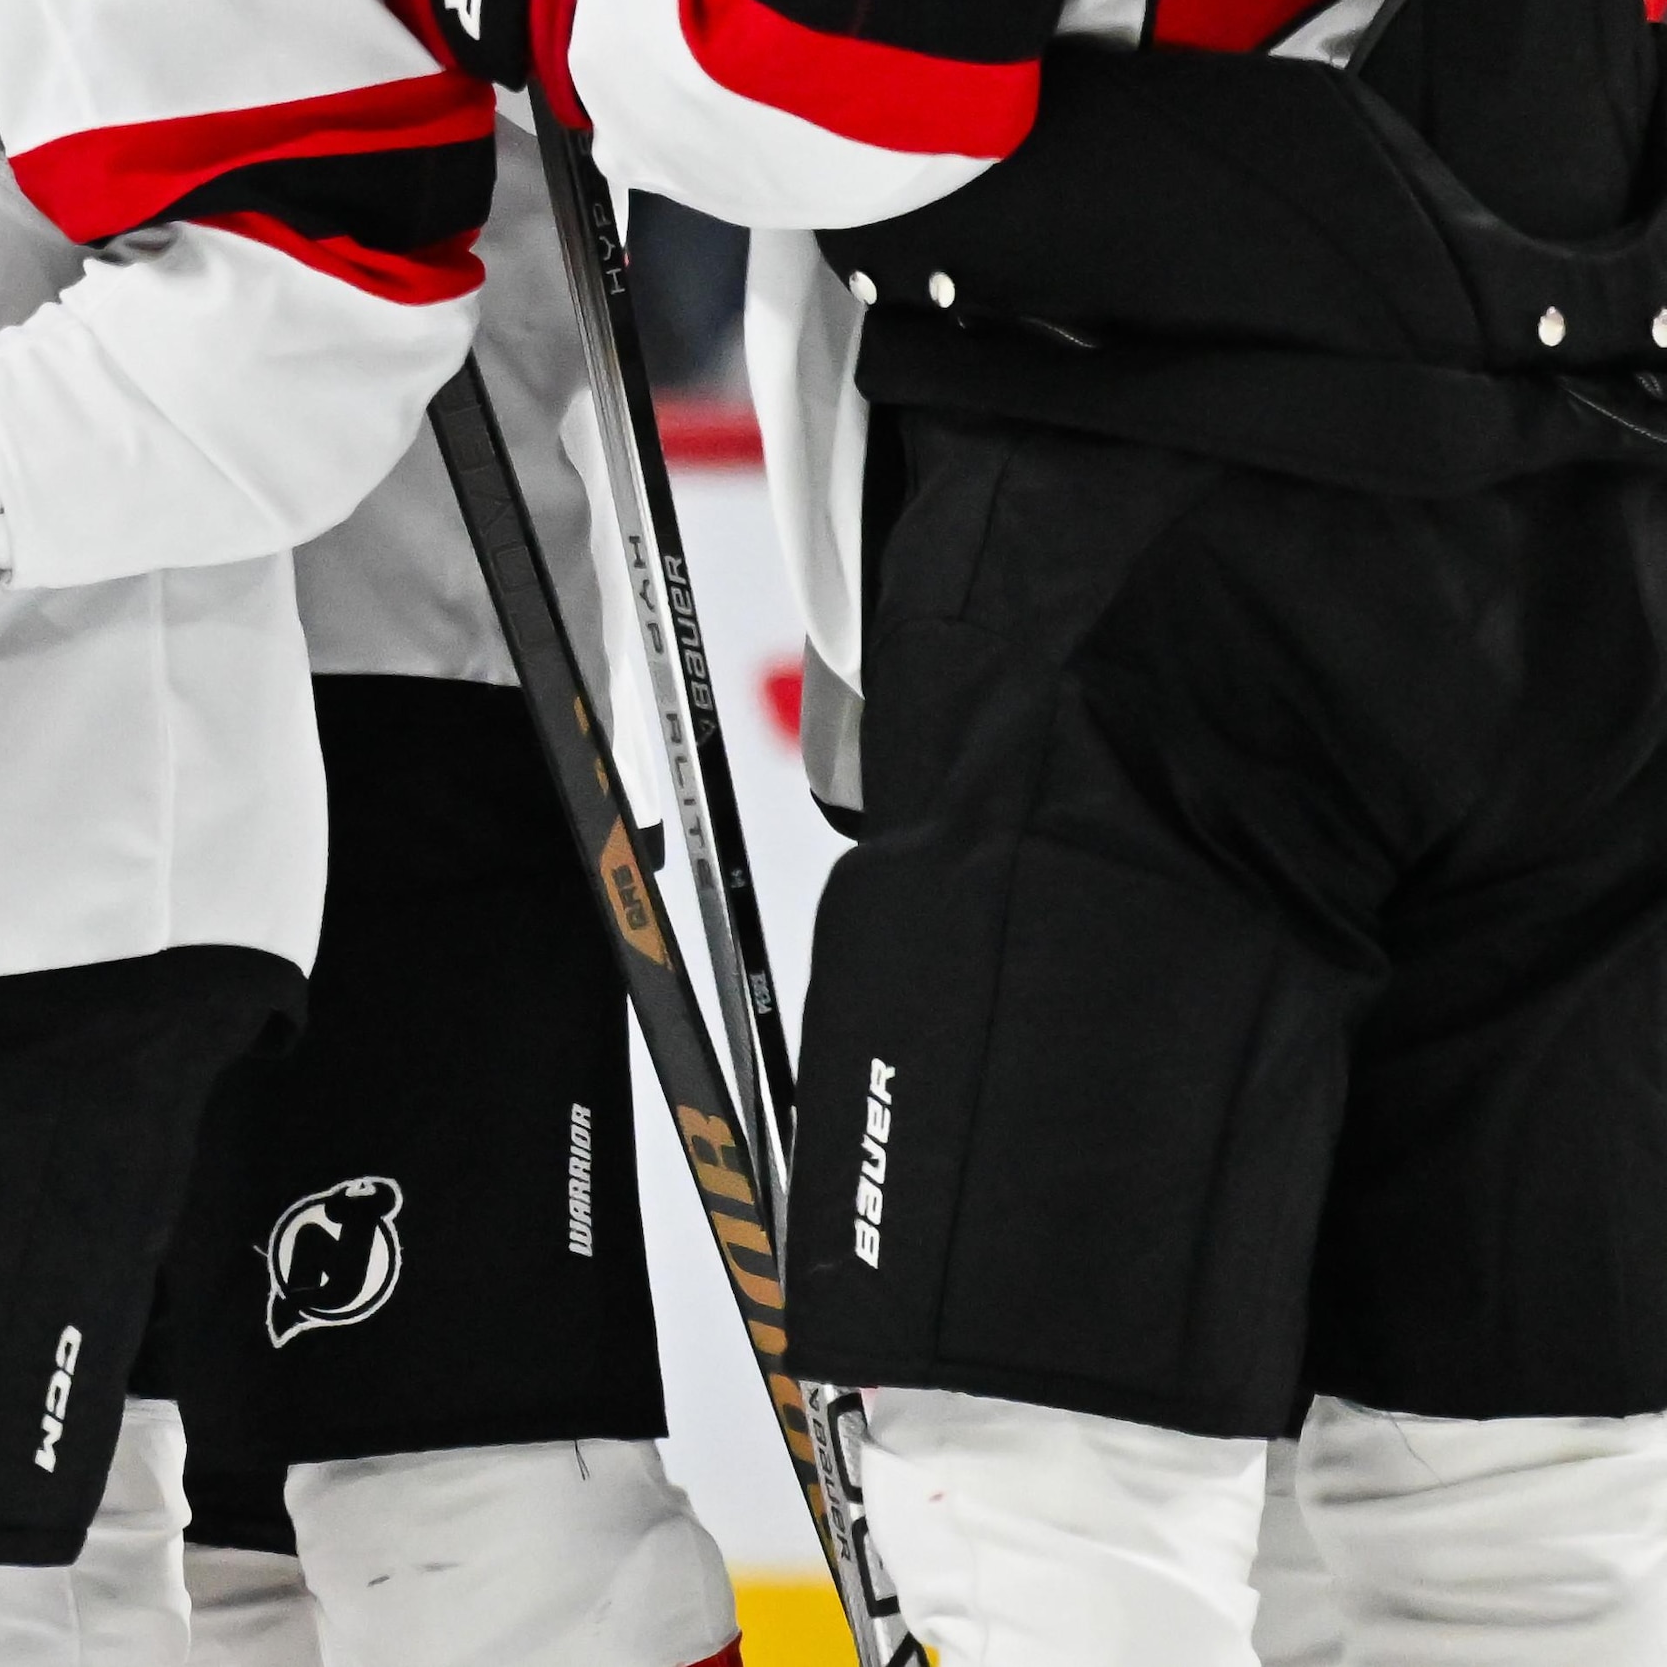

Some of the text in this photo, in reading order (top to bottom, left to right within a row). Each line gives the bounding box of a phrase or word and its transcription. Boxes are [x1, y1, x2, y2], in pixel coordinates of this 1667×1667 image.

[663, 554, 715, 711] BAUER
[569, 1102, 592, 1258] WARRIOR
[854, 1057, 896, 1270] BAUER
[32, 1324, 82, 1474] CCM
[812, 1419, 853, 1562] BAUER
